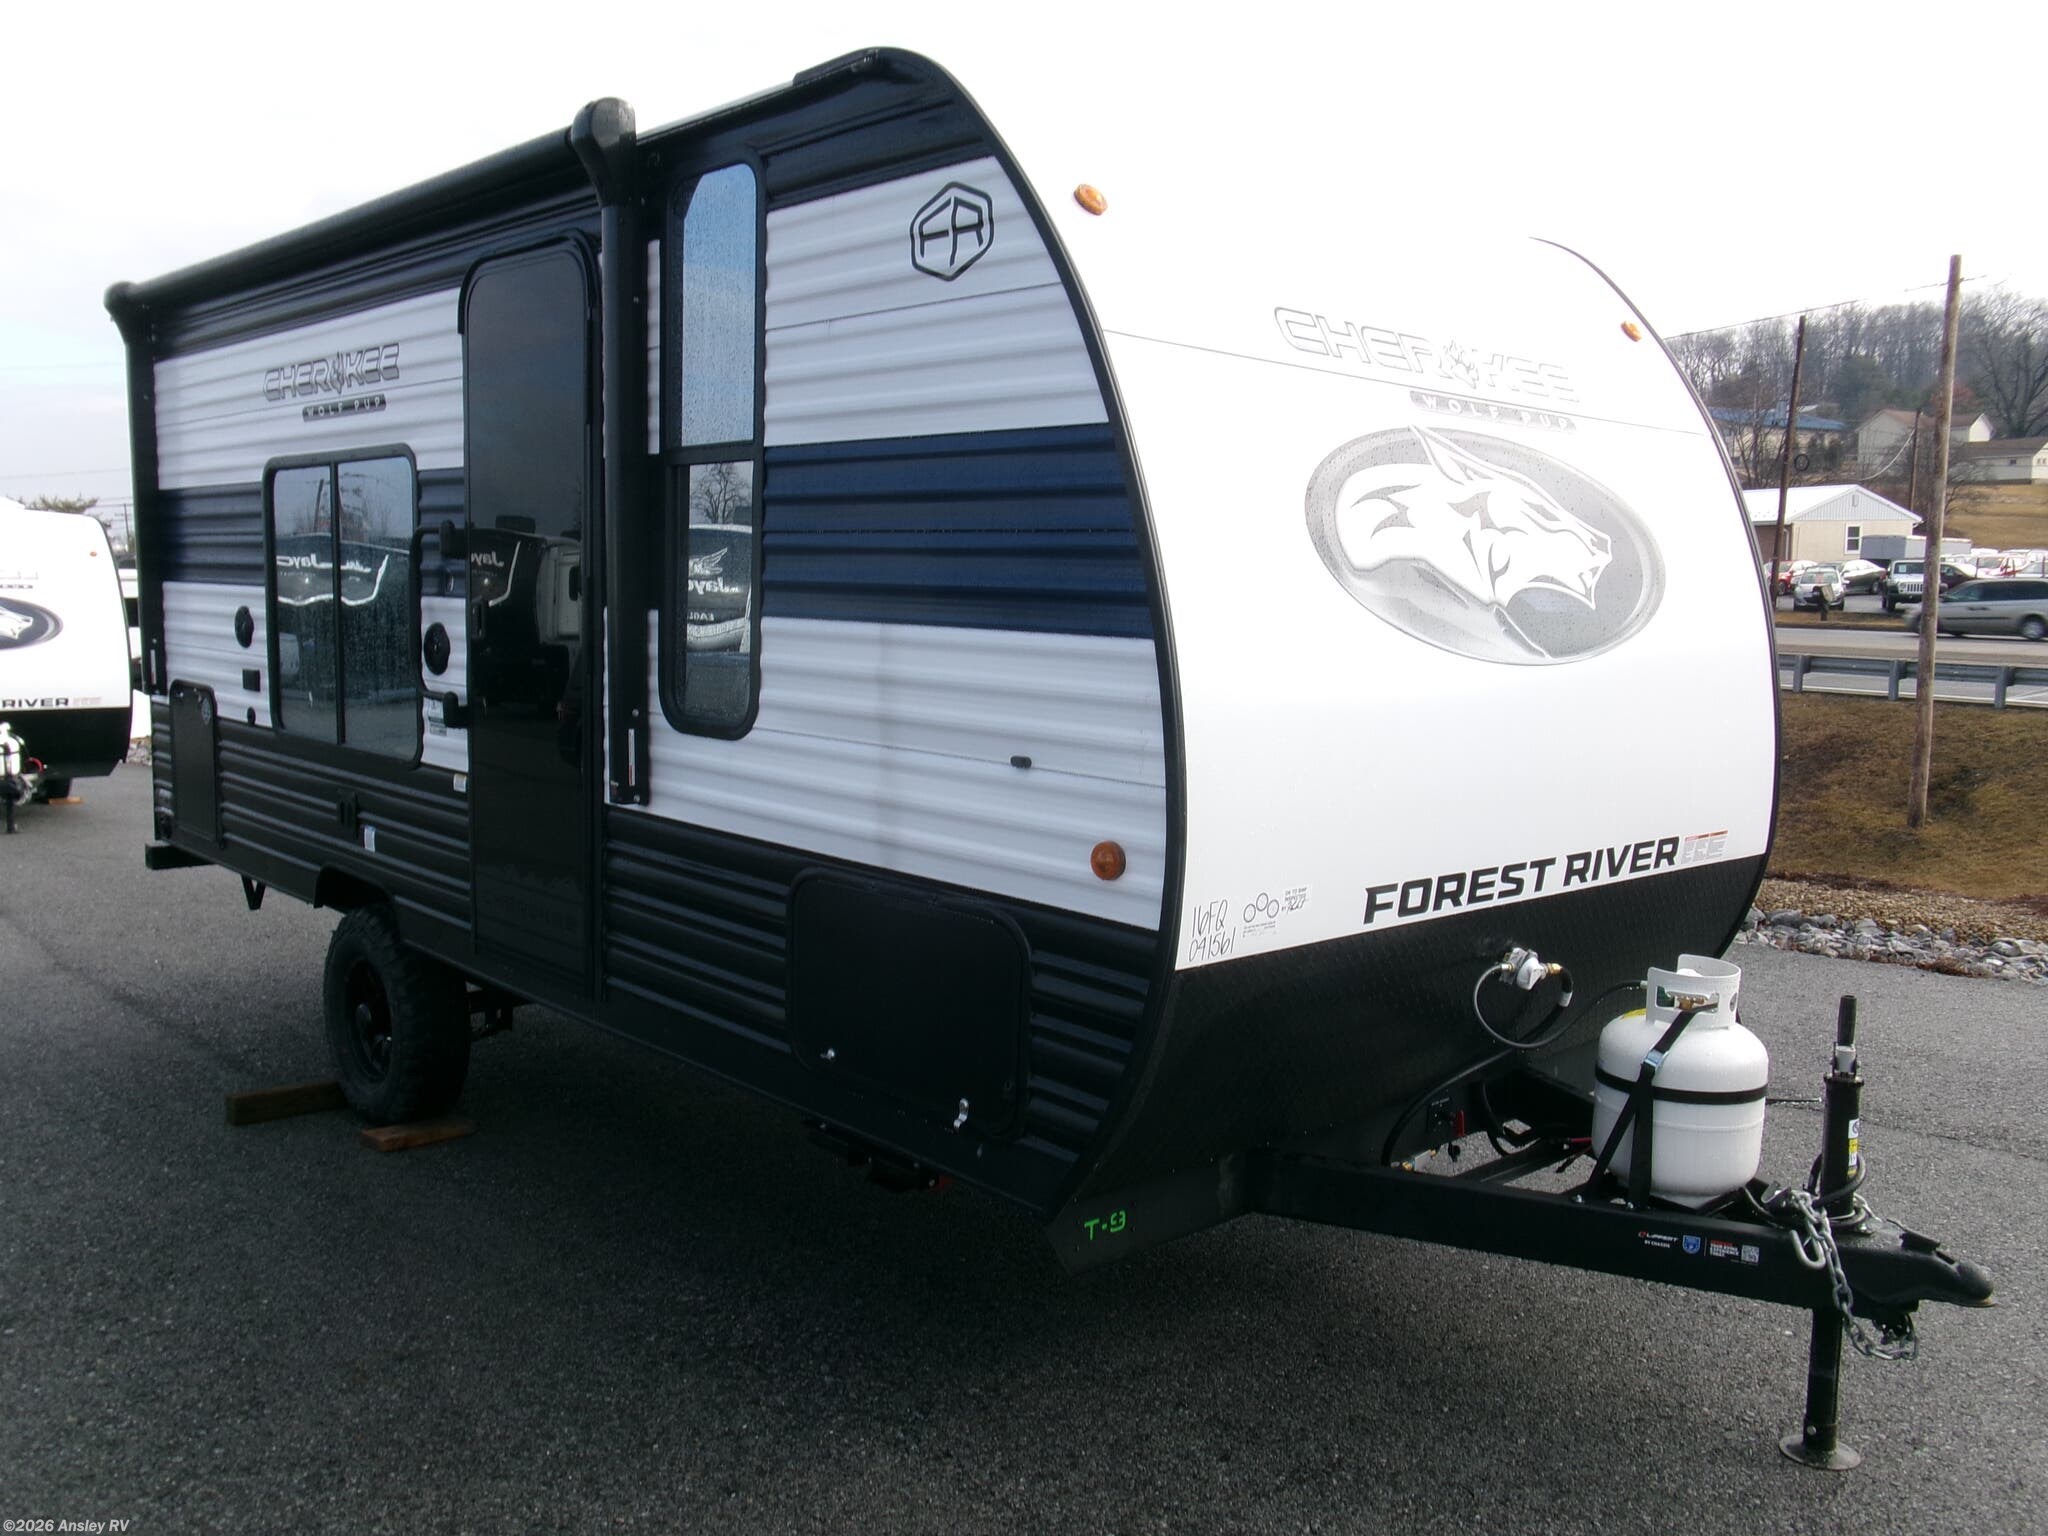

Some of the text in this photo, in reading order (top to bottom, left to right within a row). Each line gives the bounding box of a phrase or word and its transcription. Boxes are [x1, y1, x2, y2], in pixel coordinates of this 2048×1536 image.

[263, 343, 400, 402] CHEROKEE
[307, 397, 381, 417] WOLF PUP
[1422, 394, 1569, 431] WOLF PUP
[2, 697, 70, 708] RIVER
[1363, 857, 1557, 925] FOREST
[1563, 836, 1680, 888] RIVER
